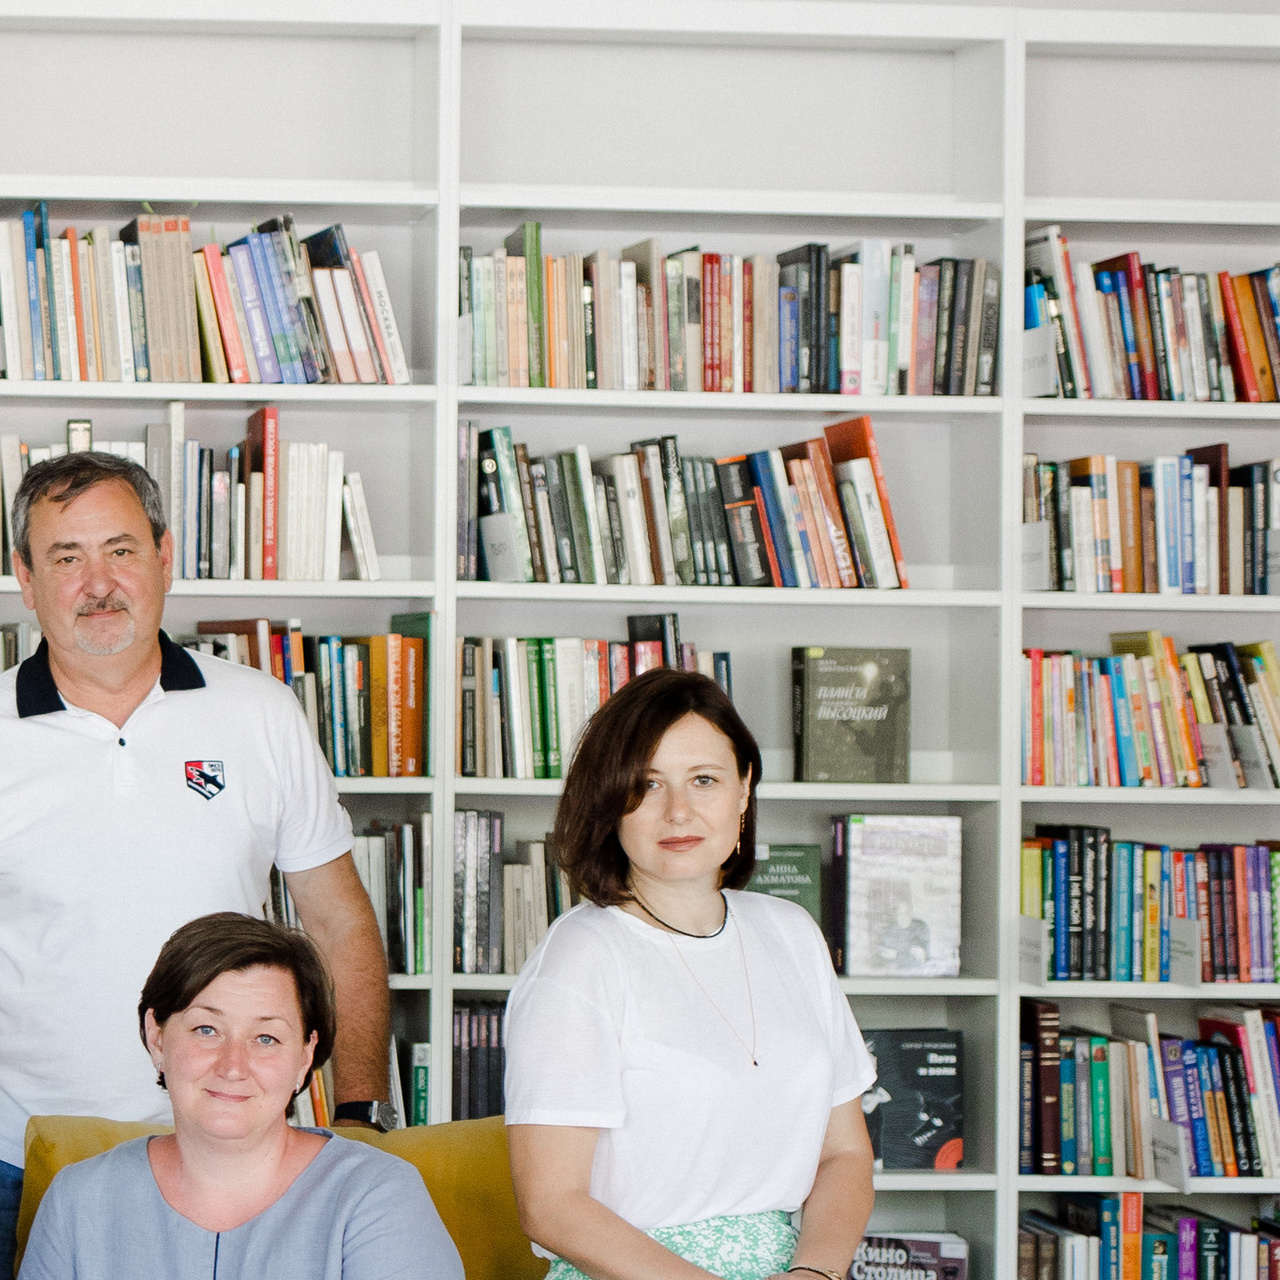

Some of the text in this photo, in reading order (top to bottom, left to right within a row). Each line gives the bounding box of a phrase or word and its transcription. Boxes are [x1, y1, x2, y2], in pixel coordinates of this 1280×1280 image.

[376, 290, 393, 339] МОСКВА
[267, 418, 275, 455] РОССИИ
[266, 456, 275, 496] СОБОРОВ
[816, 704, 888, 721] ВЫСОЦКИЙ
[769, 865, 798, 873] АННА
[756, 874, 811, 885] АХМАТОВА
[927, 1052, 957, 1064] Петя
[928, 1066, 957, 1076] волк
[853, 1241, 908, 1265] Кино
